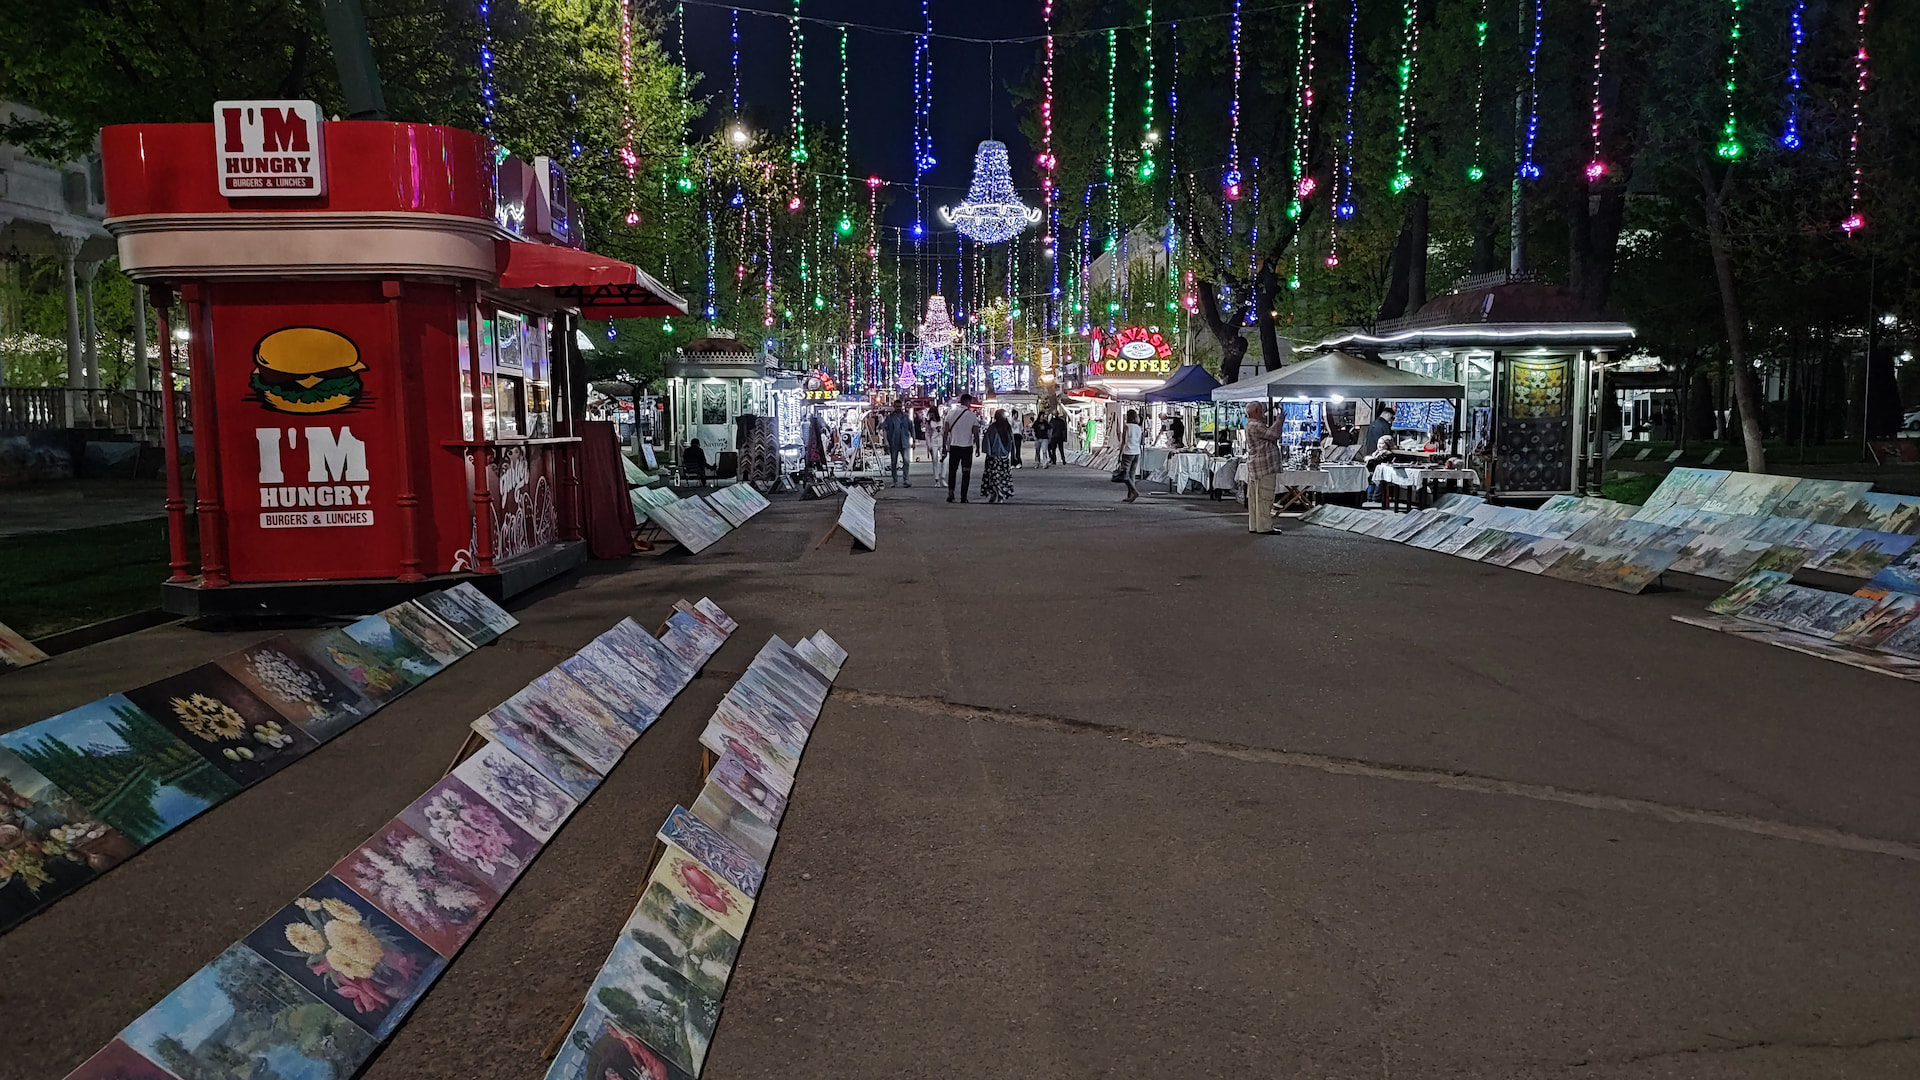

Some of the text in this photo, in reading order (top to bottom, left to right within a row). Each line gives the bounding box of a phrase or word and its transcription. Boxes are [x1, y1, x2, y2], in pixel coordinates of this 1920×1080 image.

[222, 107, 310, 152] I'M
[225, 157, 311, 174] HUNGRY
[232, 177, 306, 188] BURGERS & LUNCHES
[1106, 326, 1172, 358] LAVASH
[1105, 359, 1171, 373] COFFEE
[255, 426, 370, 484] I'M
[259, 485, 370, 508] HUNGRY
[265, 512, 368, 526] BURGERS & LUNCHES
